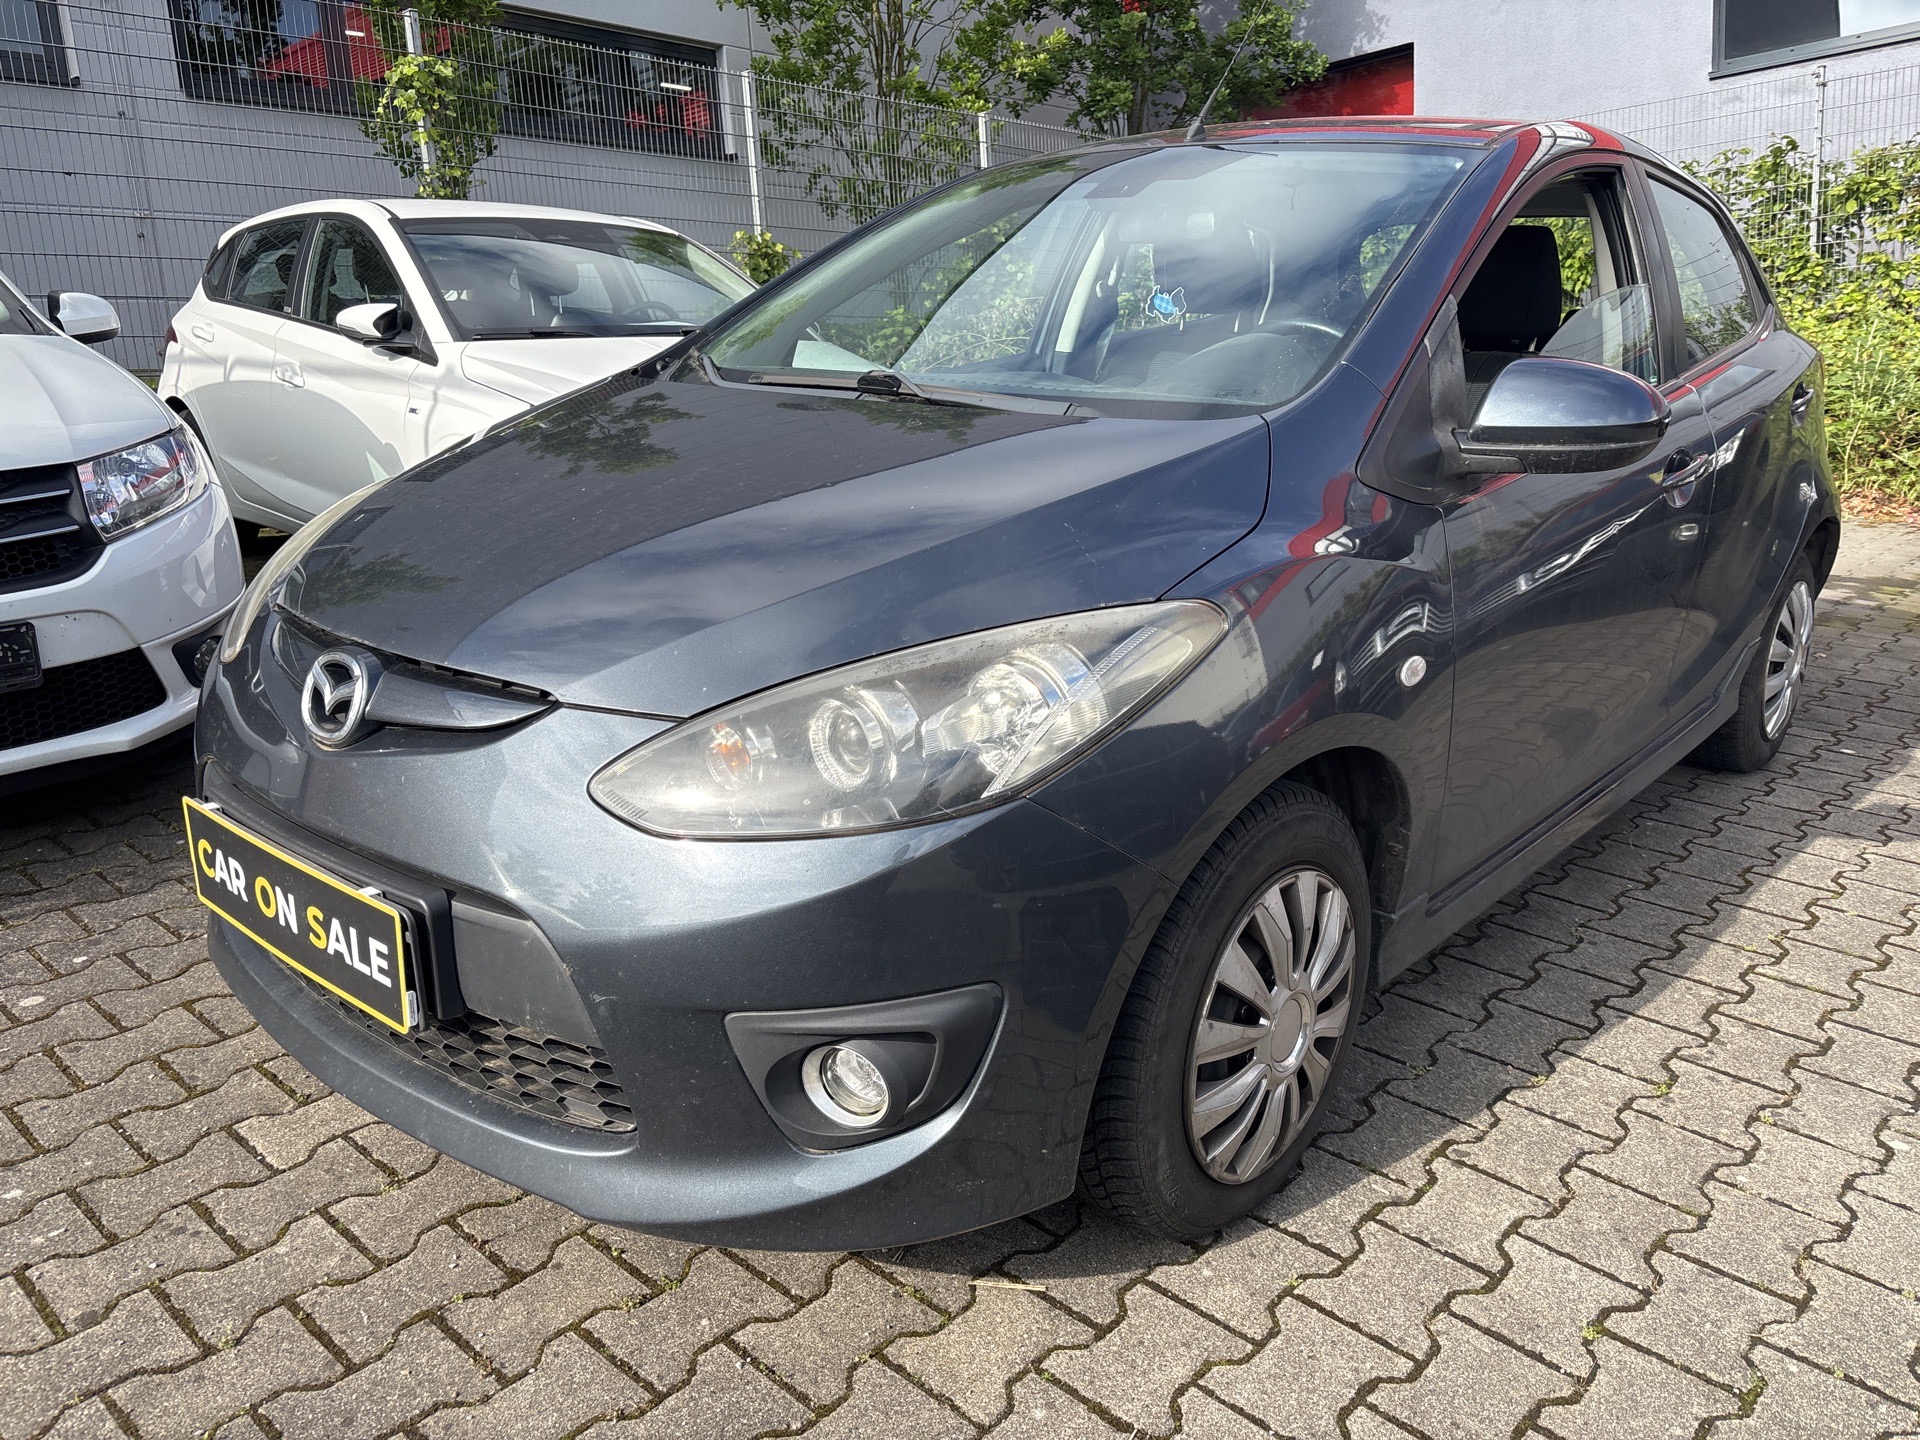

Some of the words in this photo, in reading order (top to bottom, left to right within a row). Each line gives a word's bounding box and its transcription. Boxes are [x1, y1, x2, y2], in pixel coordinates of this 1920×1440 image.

[198, 839, 248, 902] CAR
[255, 877, 298, 934] ON
[306, 906, 391, 988] SALE
